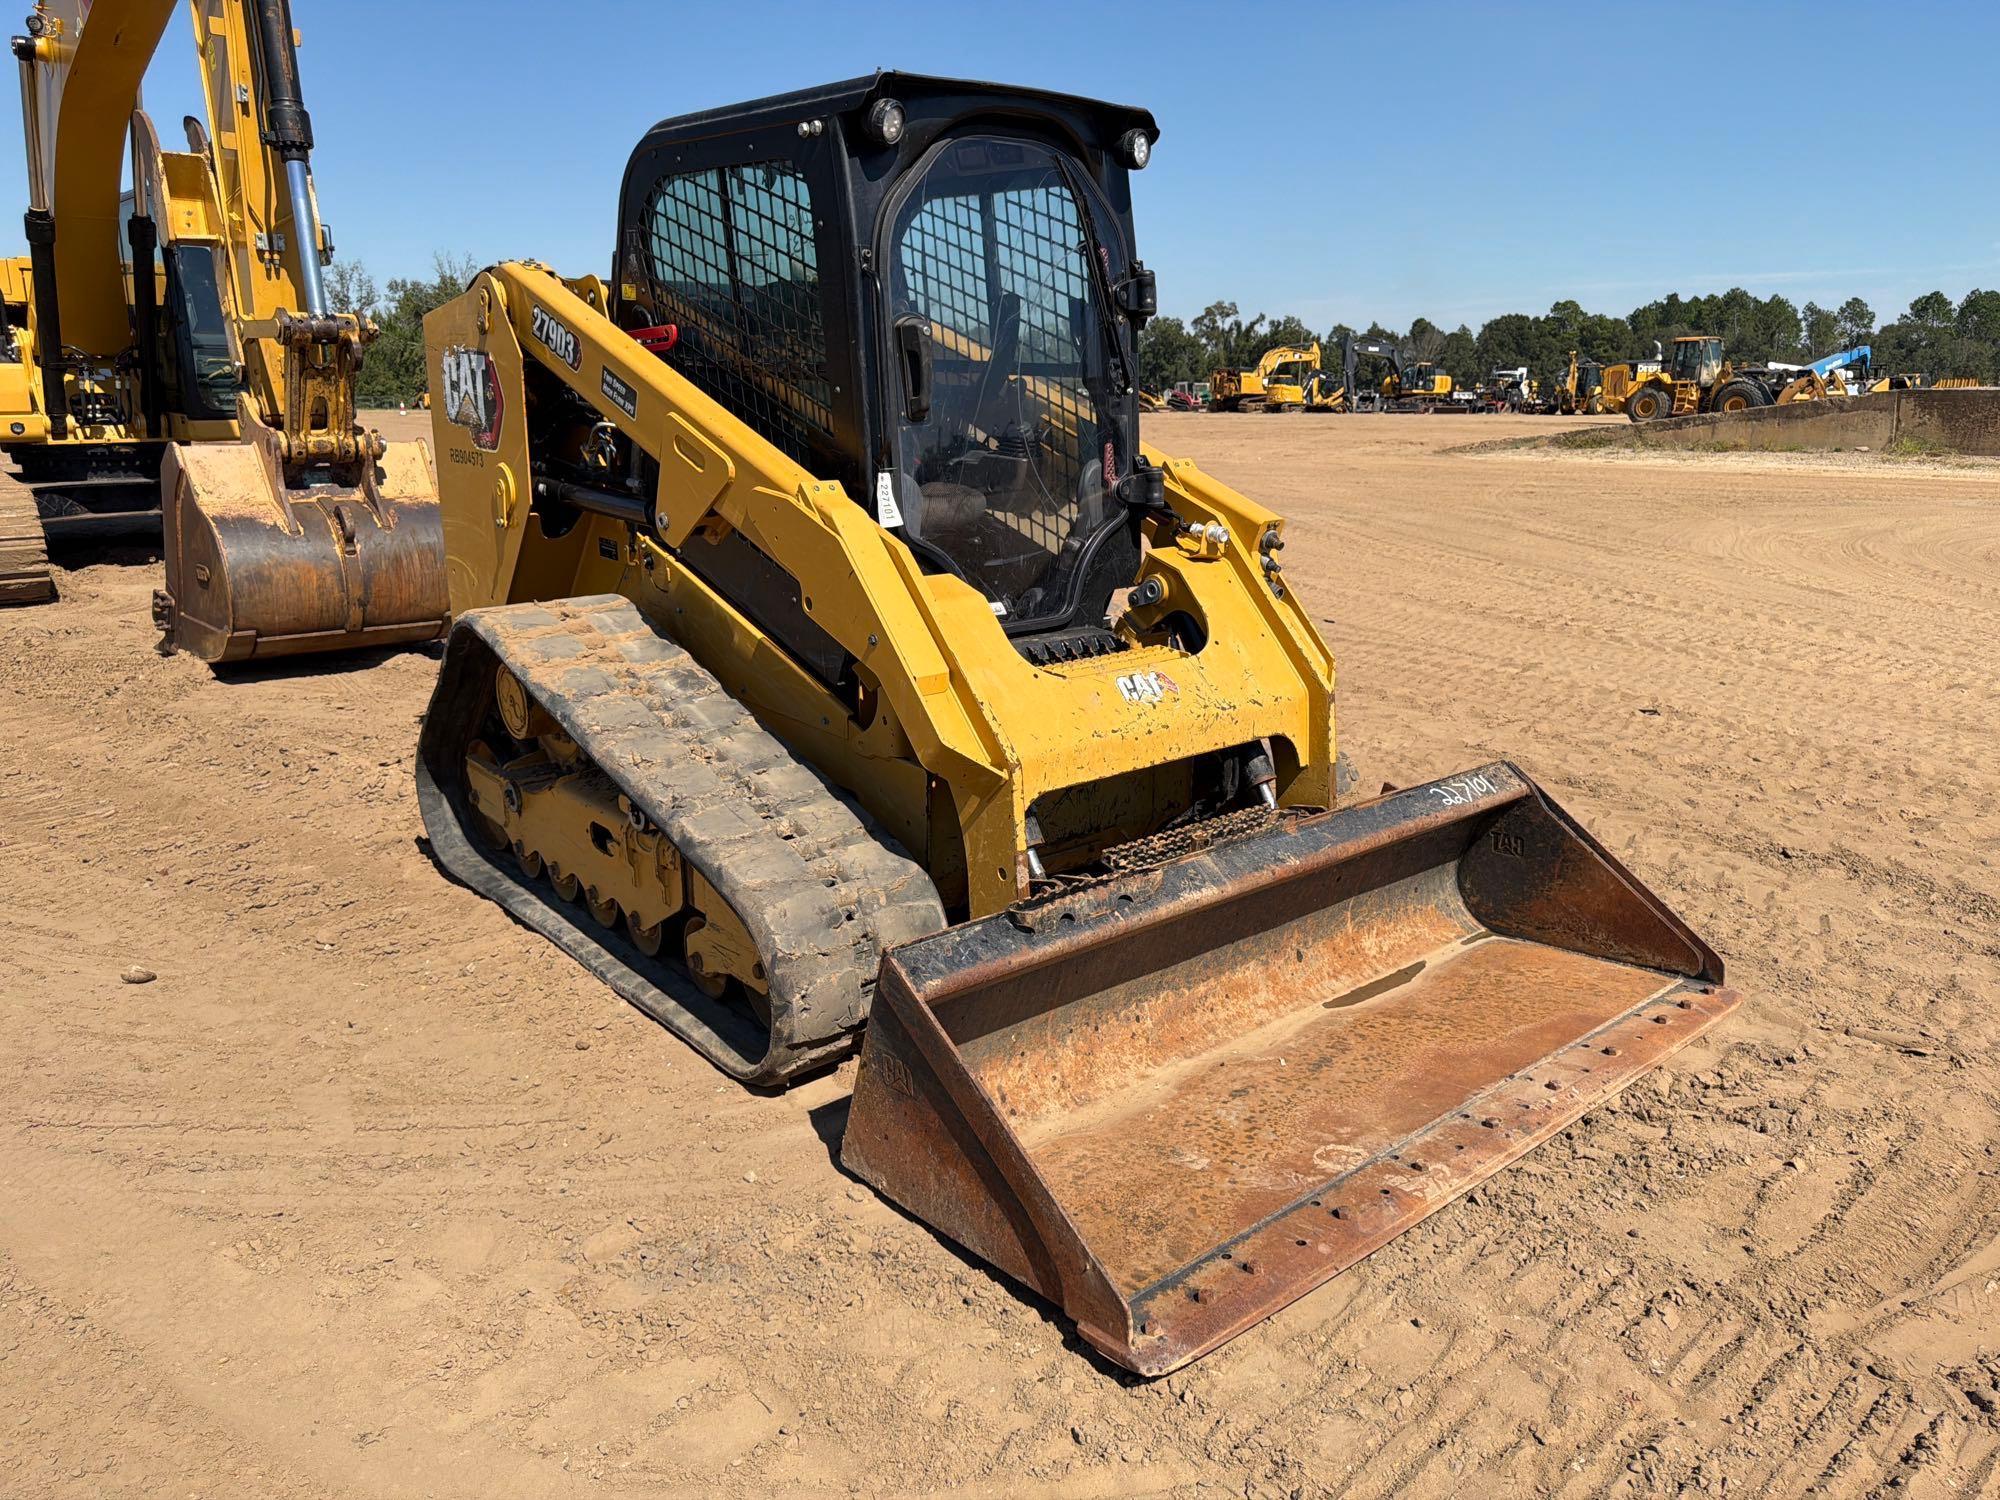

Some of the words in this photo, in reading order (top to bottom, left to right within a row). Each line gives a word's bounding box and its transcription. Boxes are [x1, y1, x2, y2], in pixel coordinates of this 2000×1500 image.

[533, 306, 574, 365] 279D3
[443, 353, 487, 428] CAT
[449, 448, 484, 468] RB904573
[881, 484, 895, 519] 227101
[1430, 774, 1497, 805] 227101
